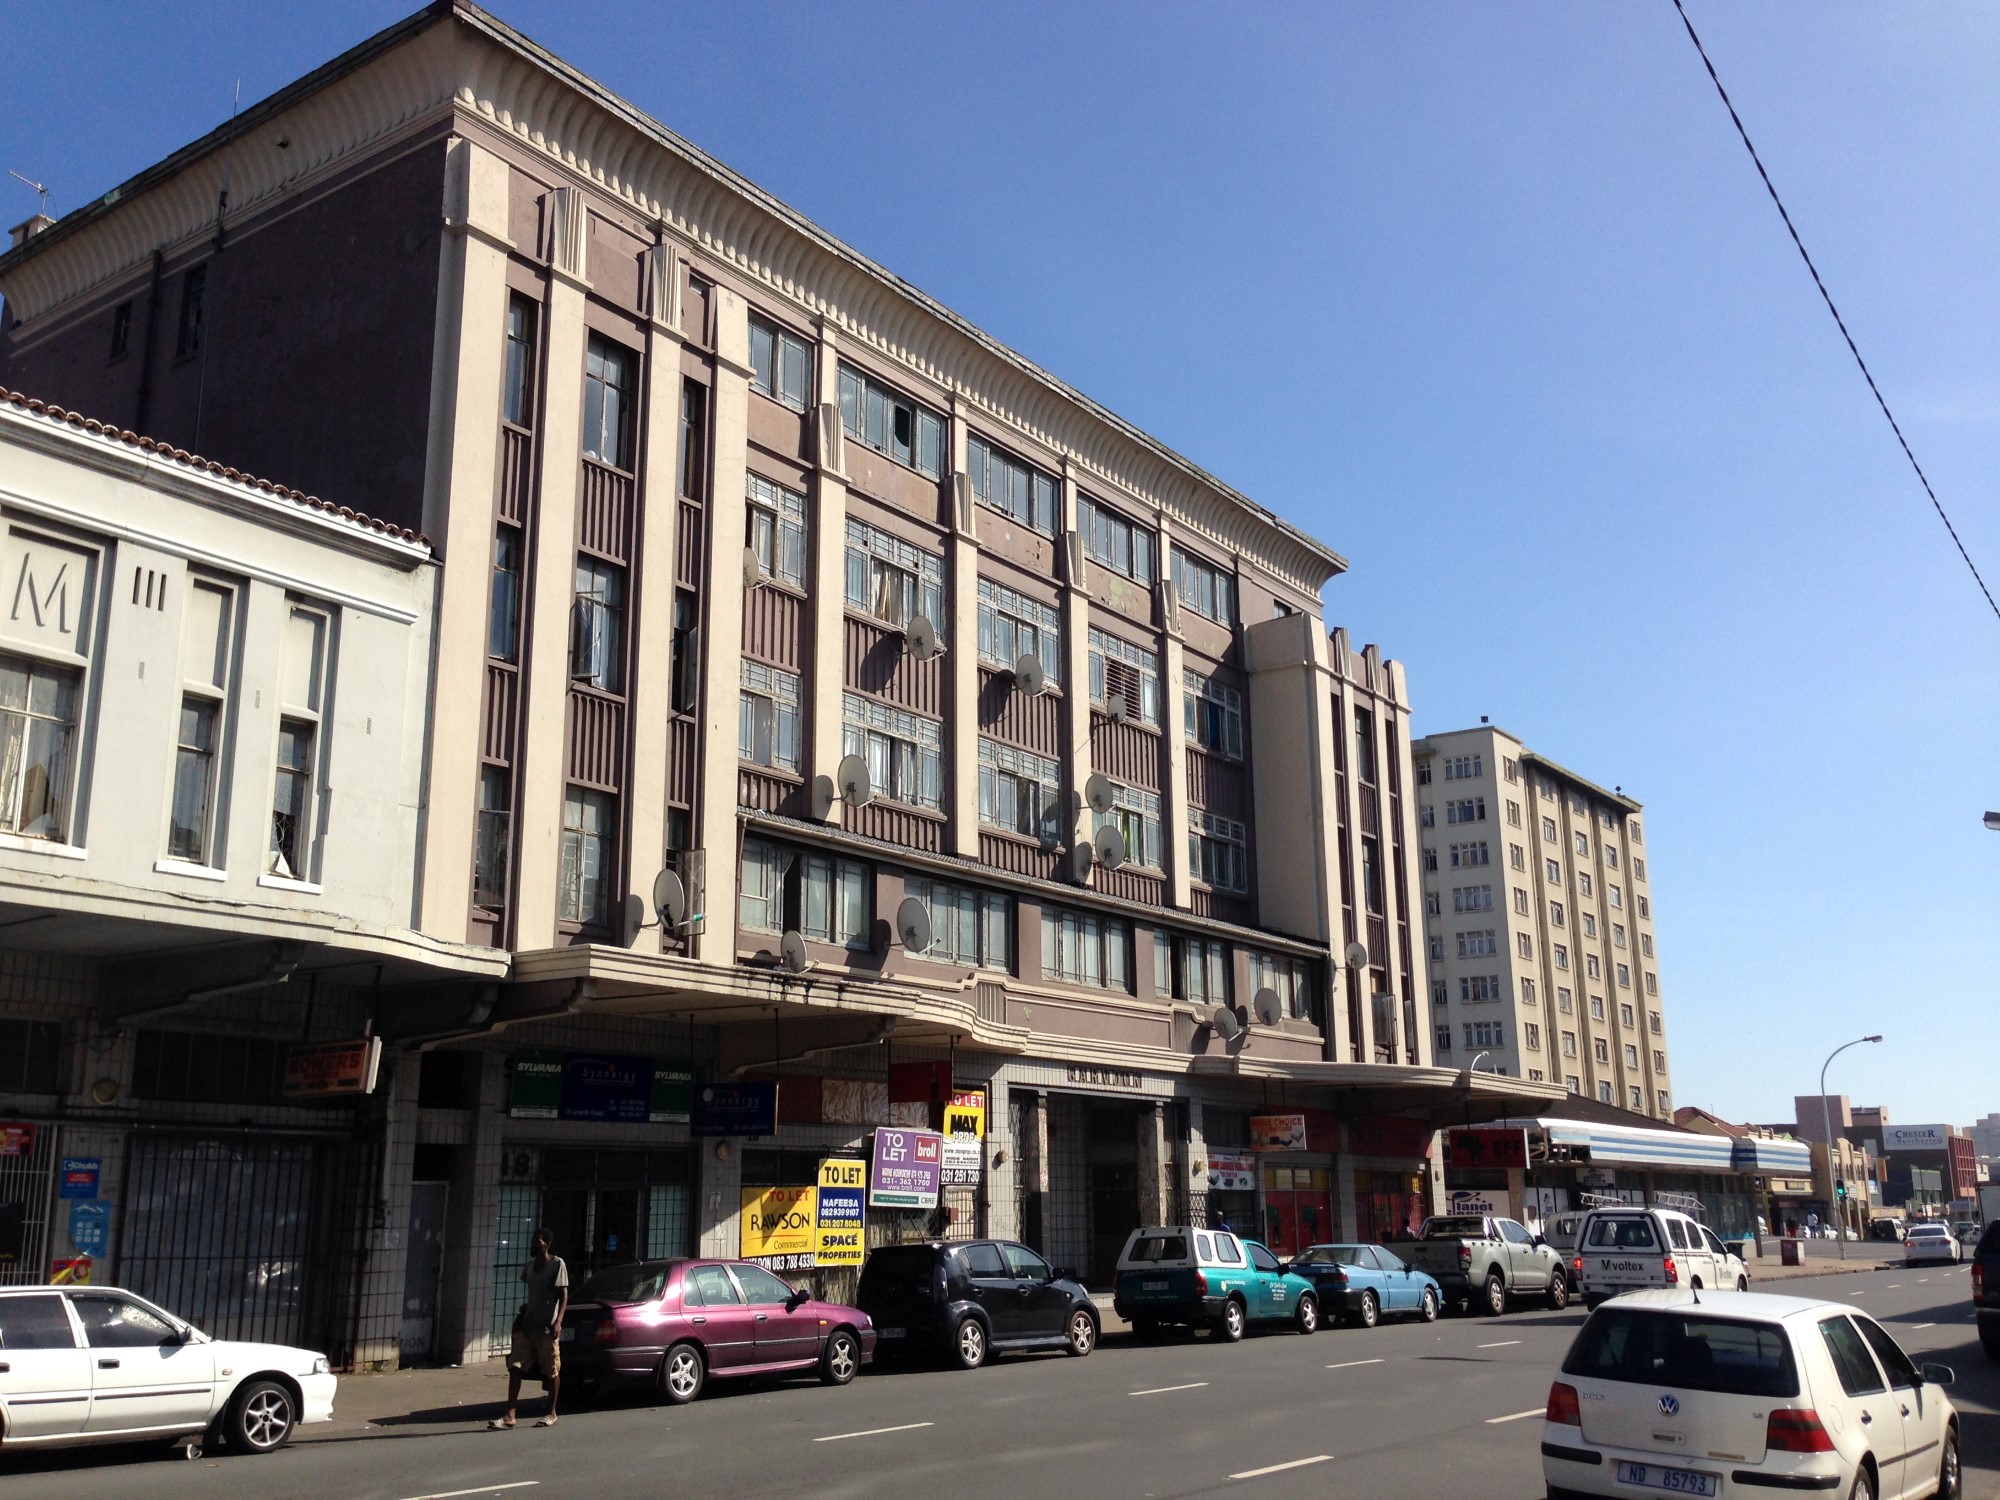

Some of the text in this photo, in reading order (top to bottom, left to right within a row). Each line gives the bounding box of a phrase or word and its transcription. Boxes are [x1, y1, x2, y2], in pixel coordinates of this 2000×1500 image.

[517, 1062, 562, 1073] SYLVANIA
[581, 1067, 637, 1082] Synnergy
[654, 1071, 692, 1081] SYLVANIA
[964, 1095, 983, 1107] LET
[949, 1114, 979, 1135] MAX
[1274, 1117, 1302, 1126] CHOICE
[884, 1133, 904, 1148] TO
[1895, 1130, 1935, 1138] CHESTER
[917, 1142, 936, 1158] broll
[1493, 1140, 1522, 1155] EFF
[882, 1148, 907, 1162] LET
[73, 1160, 99, 1170] Chubb
[824, 1166, 861, 1184] TO LET
[941, 1169, 953, 1182] 031
[954, 1169, 966, 1183] 251
[769, 1189, 810, 1202] TO LET
[822, 1198, 859, 1207] NAFEESA
[820, 1208, 833, 1216] 082
[846, 1208, 860, 1216] 9107
[750, 1212, 810, 1231] RAWSON
[820, 1219, 861, 1227] 031 207 8048
[773, 1239, 808, 1250] Commercial
[822, 1234, 858, 1247] SPACE
[817, 1250, 861, 1259] PROPERTIES
[772, 1255, 785, 1270] 083
[786, 1254, 798, 1269] 788
[798, 1253, 814, 1269] 4330
[1612, 1259, 1644, 1271] voltex
[1629, 1465, 1706, 1492] ND 85793
